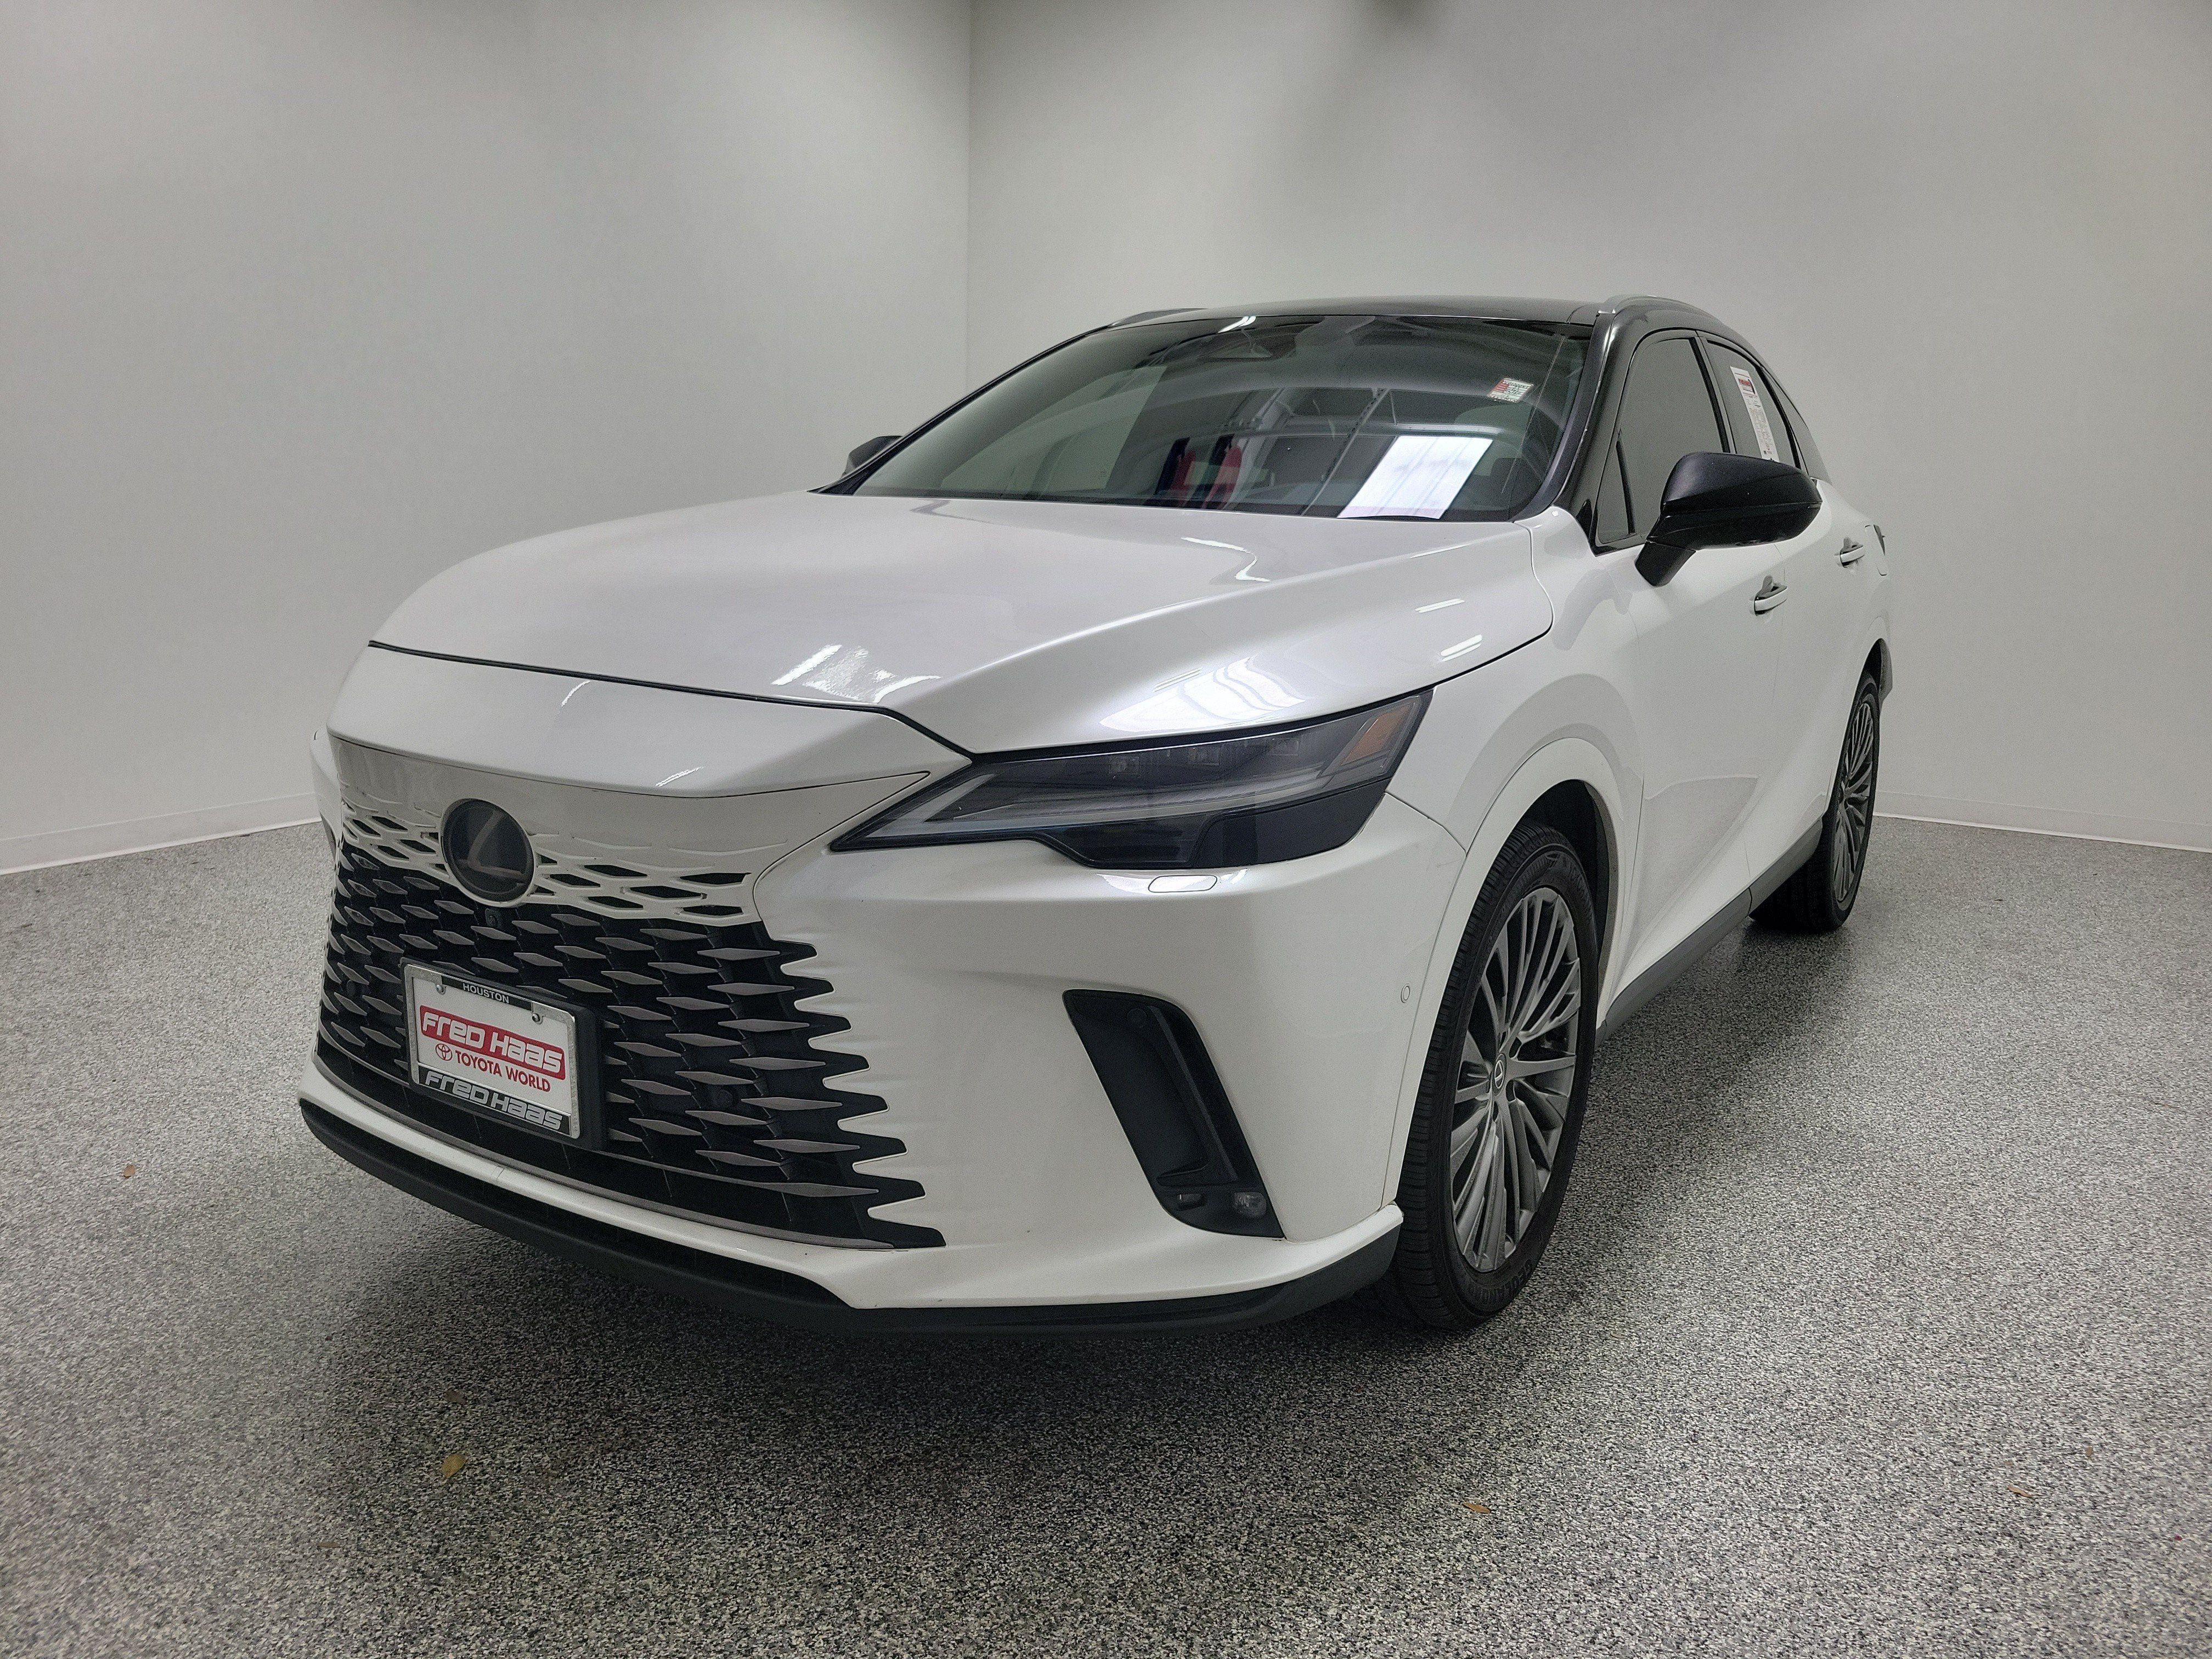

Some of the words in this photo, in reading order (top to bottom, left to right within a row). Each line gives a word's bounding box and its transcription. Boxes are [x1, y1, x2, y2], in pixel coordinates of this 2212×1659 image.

[462, 983, 510, 1004] HOUSTON
[455, 1049, 503, 1077] TOYOTA
[506, 1065, 551, 1092] WORLD
